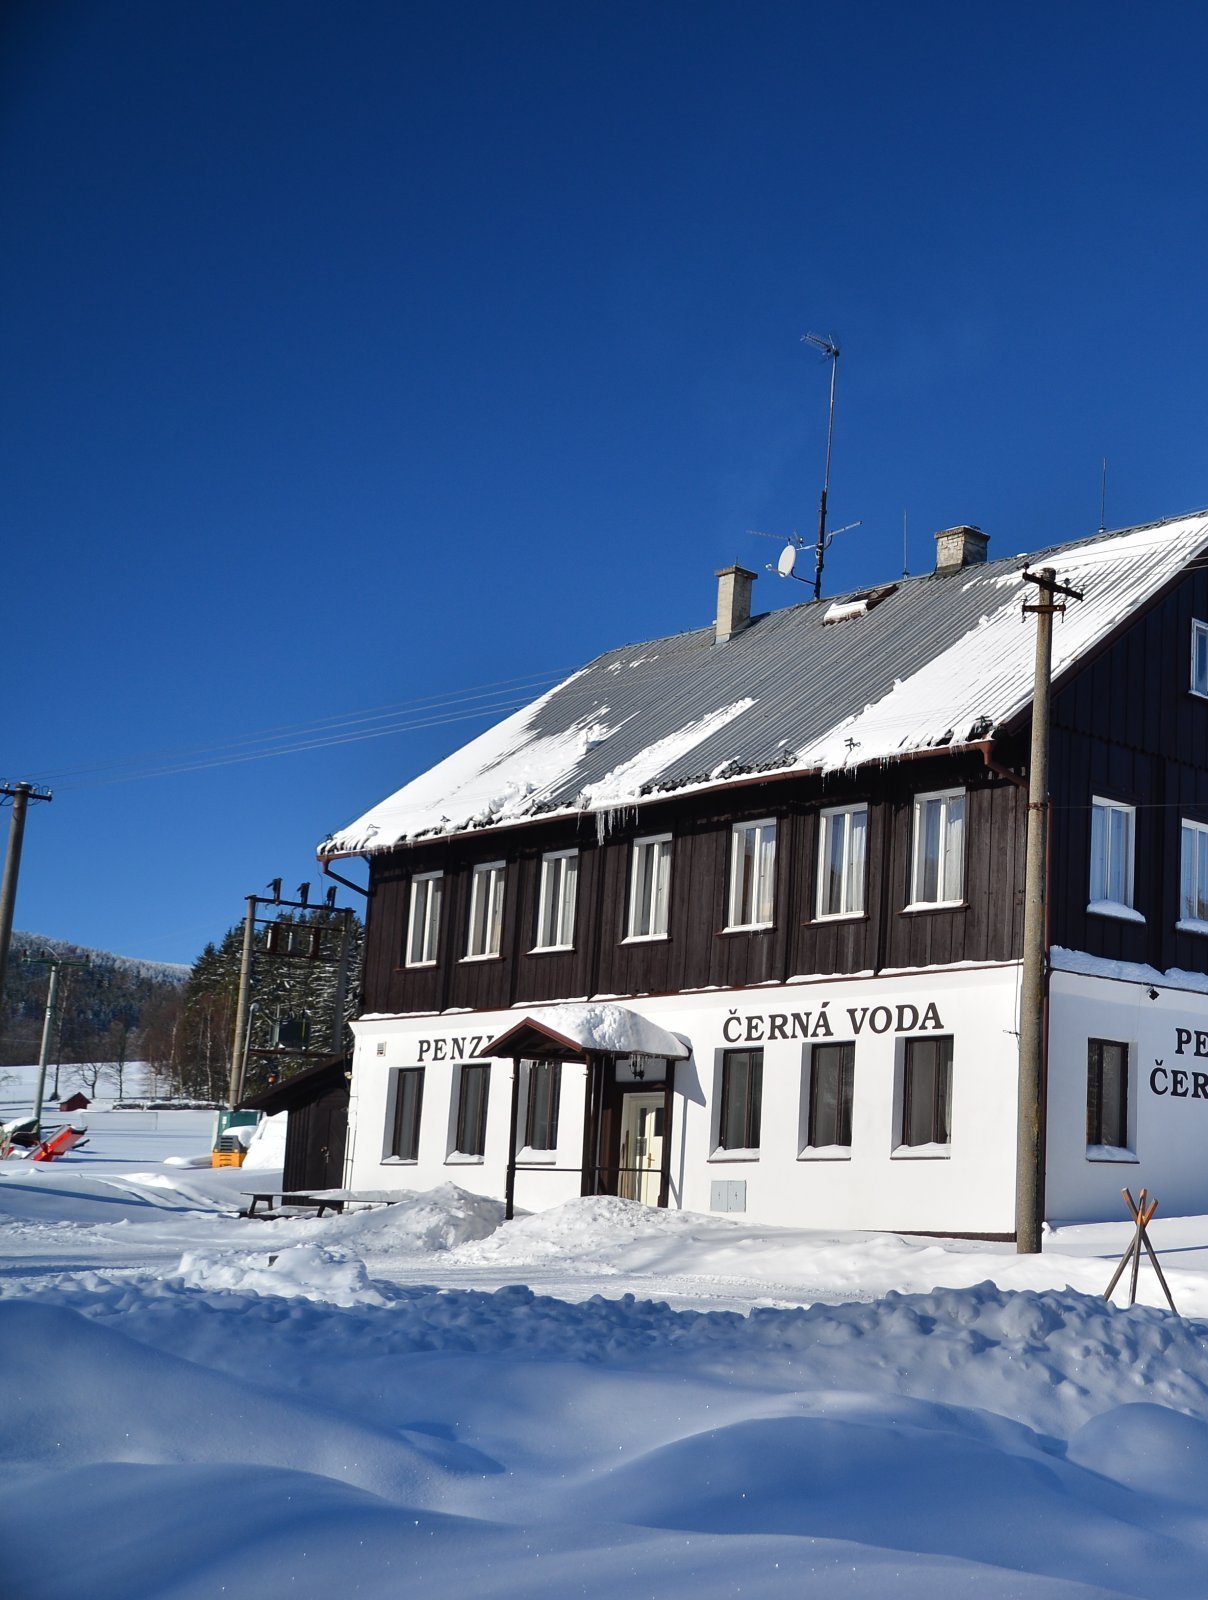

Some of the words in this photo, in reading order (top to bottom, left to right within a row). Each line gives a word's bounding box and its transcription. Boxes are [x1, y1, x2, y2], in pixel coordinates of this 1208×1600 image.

[417, 1035, 494, 1062] PENZ
[723, 1001, 834, 1043] ČERNÁ
[846, 1002, 945, 1035] VODA
